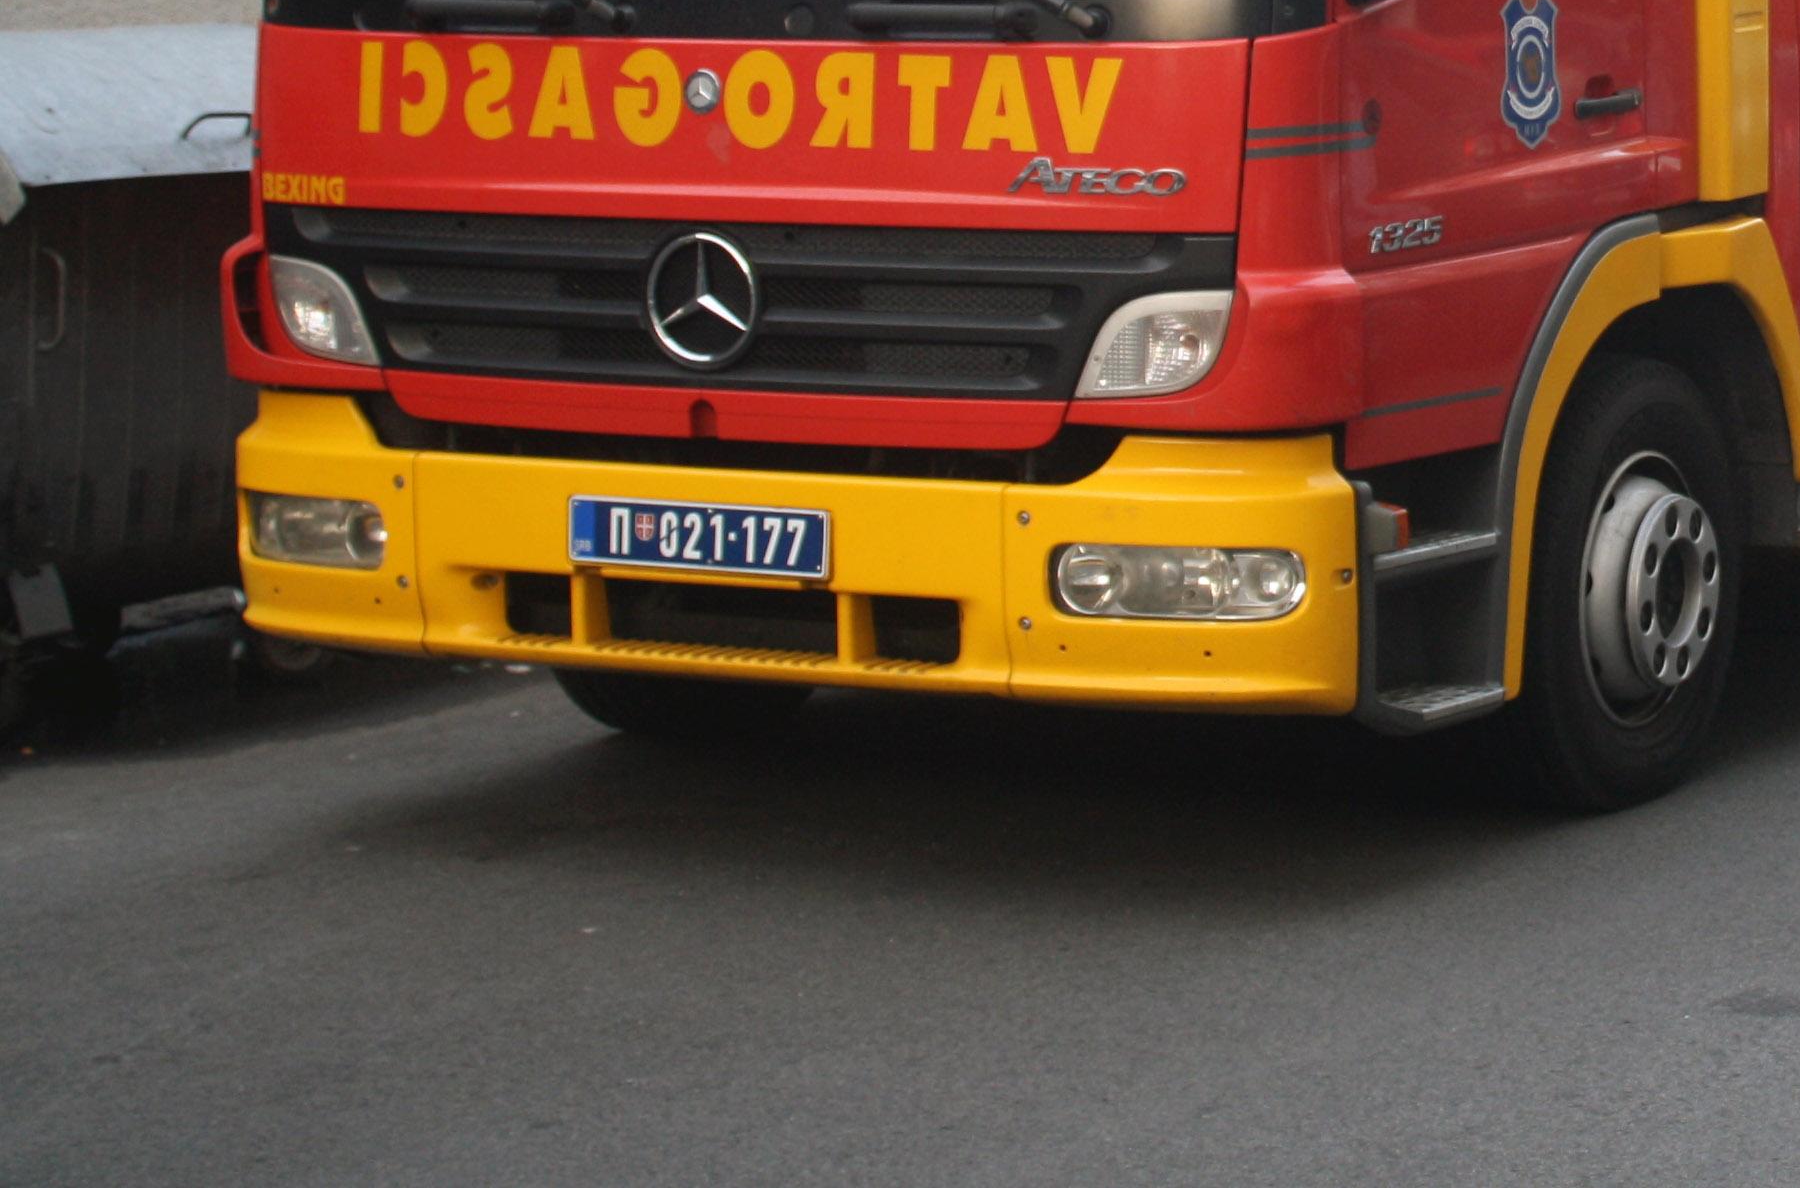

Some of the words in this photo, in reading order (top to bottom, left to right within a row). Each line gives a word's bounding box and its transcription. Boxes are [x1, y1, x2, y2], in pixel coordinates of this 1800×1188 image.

[262, 172, 346, 205] BEXING
[1008, 157, 1187, 196] ATEGO
[1370, 216, 1442, 254] 1325
